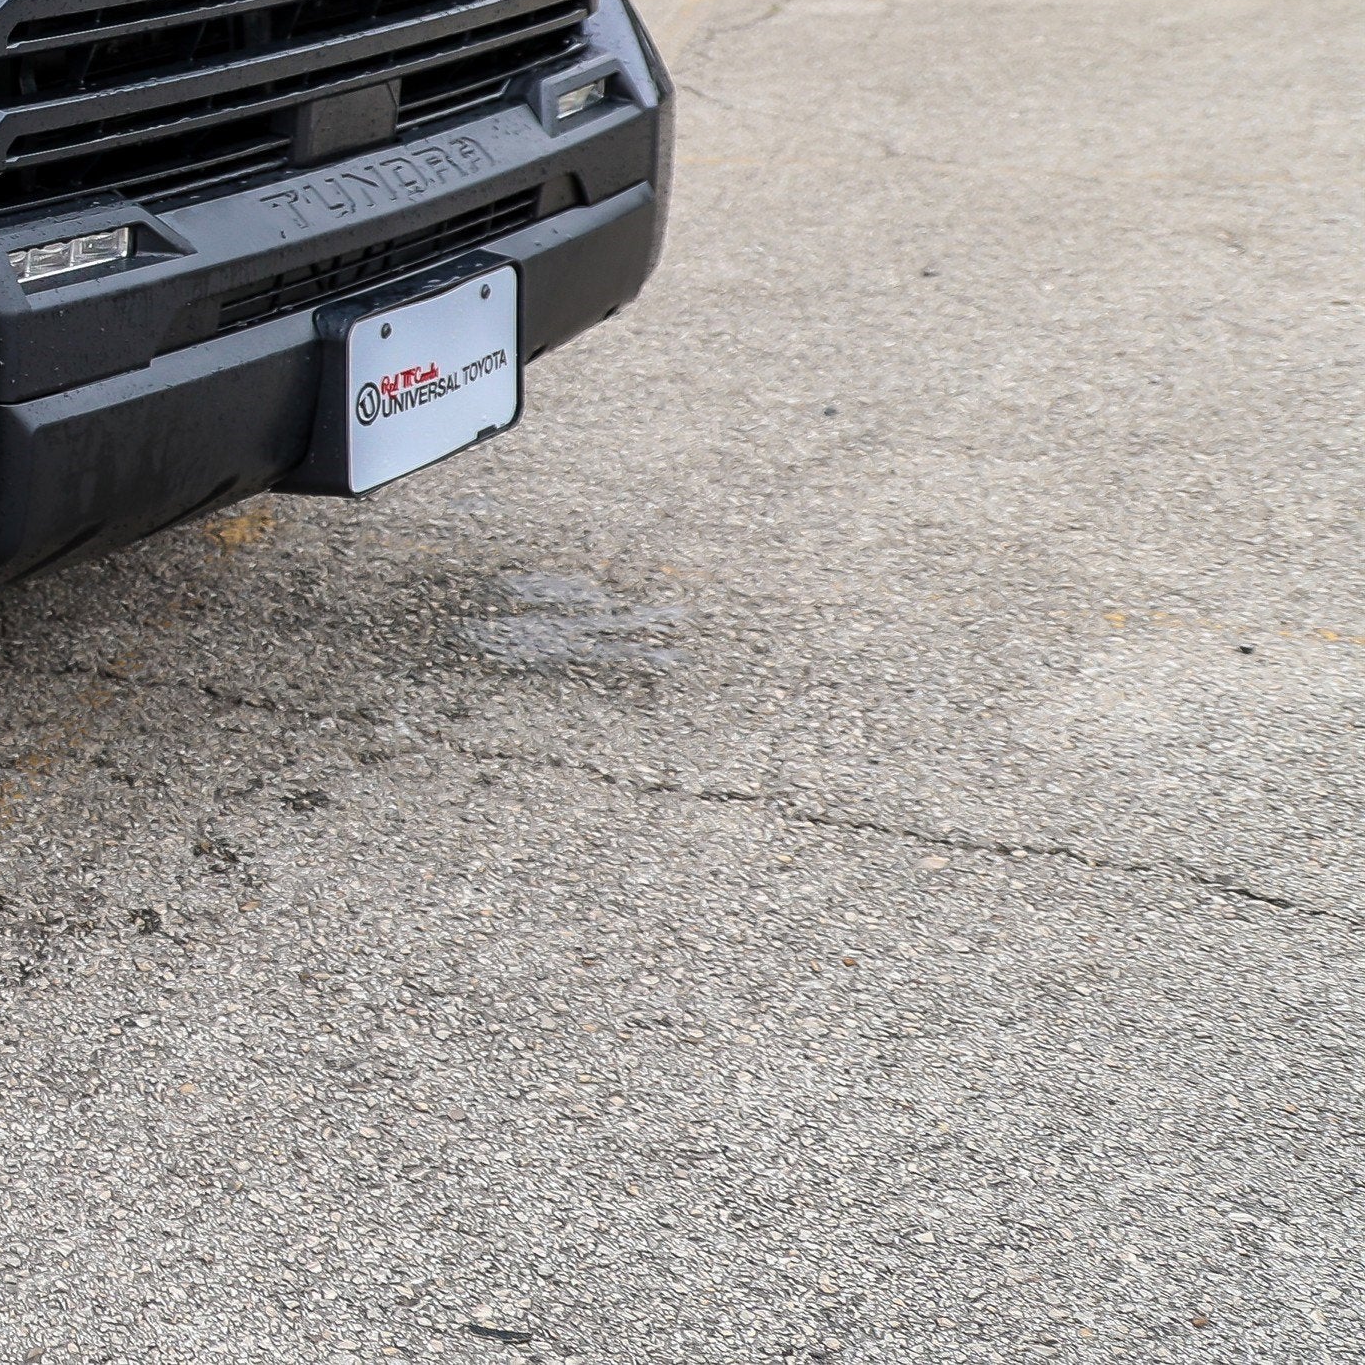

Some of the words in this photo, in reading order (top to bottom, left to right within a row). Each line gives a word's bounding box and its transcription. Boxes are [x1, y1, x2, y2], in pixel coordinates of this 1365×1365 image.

[260, 136, 495, 231] TUNDRA
[382, 372, 461, 418] UNIVERSAL
[462, 349, 508, 385] TOYOTA
